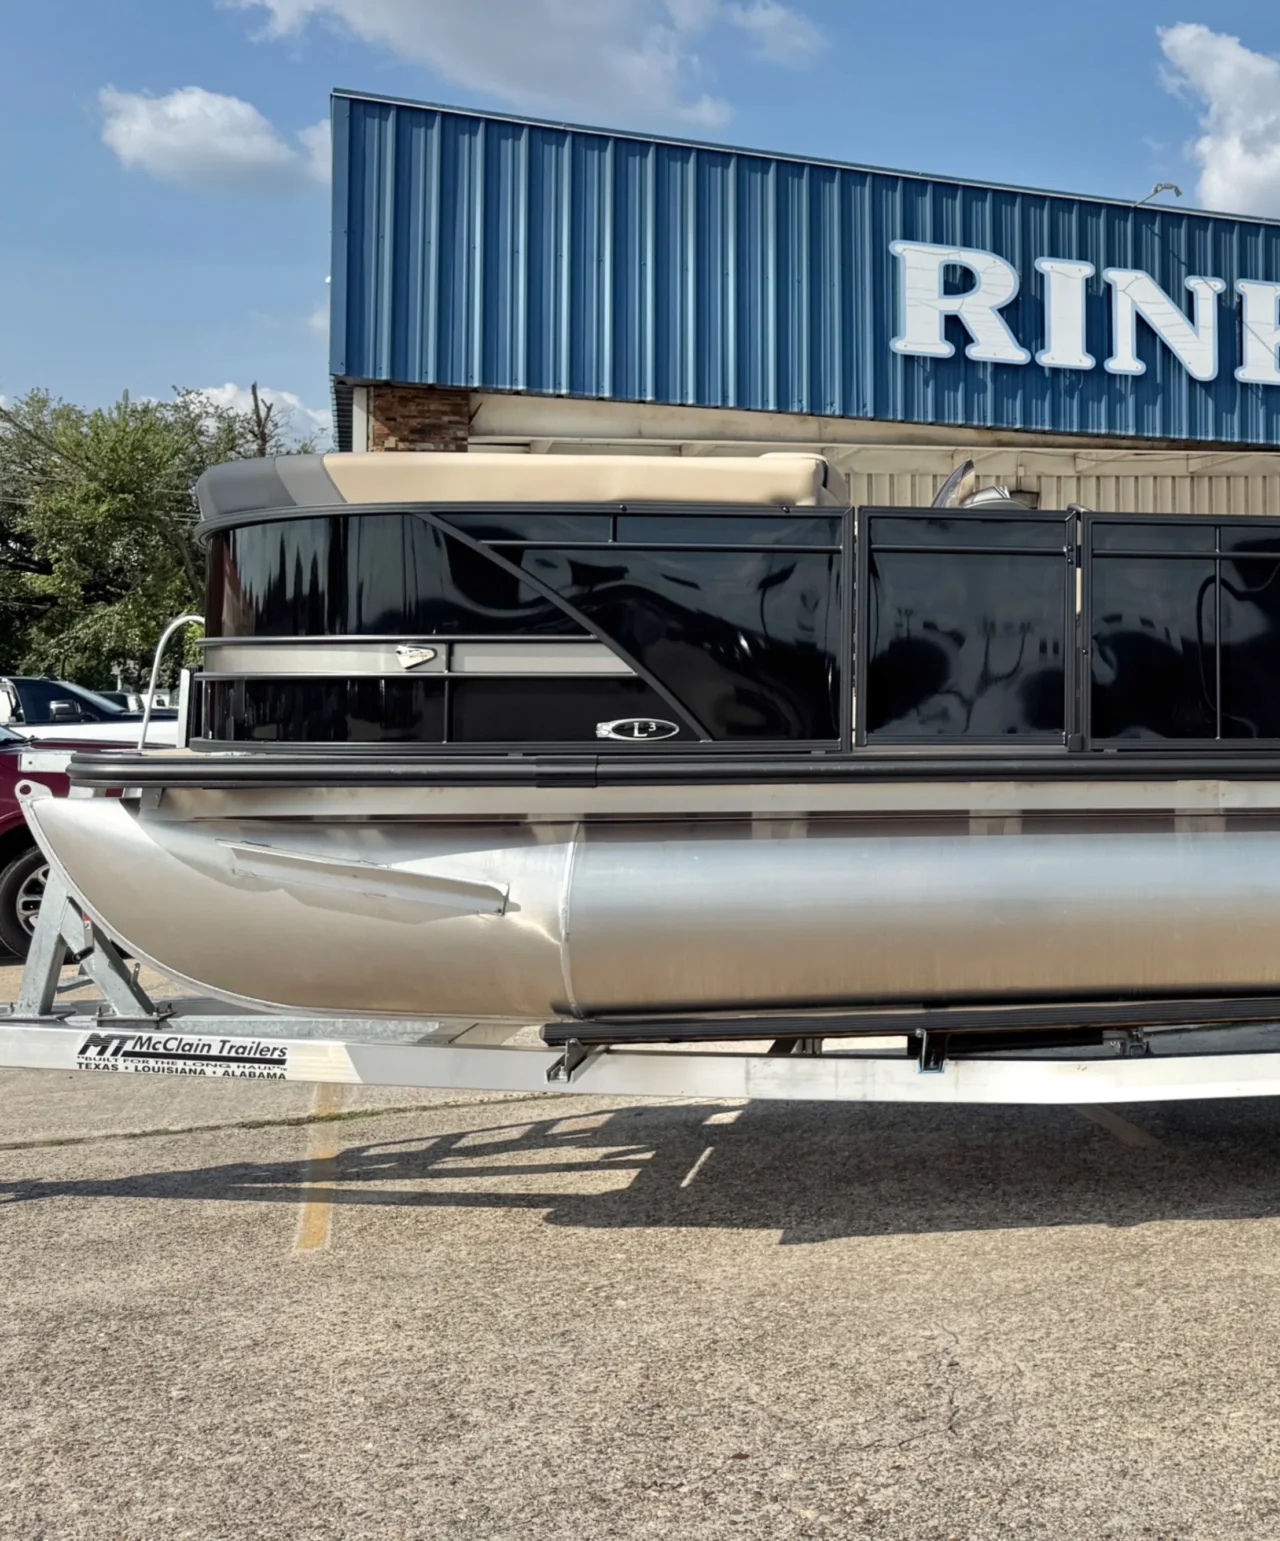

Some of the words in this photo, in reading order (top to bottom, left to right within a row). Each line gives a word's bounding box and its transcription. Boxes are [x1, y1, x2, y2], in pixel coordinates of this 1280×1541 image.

[131, 1035, 212, 1053] McClain
[218, 1039, 288, 1058] Trailers
[77, 1062, 119, 1072] TEXAS
[134, 1065, 206, 1076] LOUISIANA
[222, 1069, 286, 1080] ALABAMA
[183, 1061, 231, 1069] LONG
